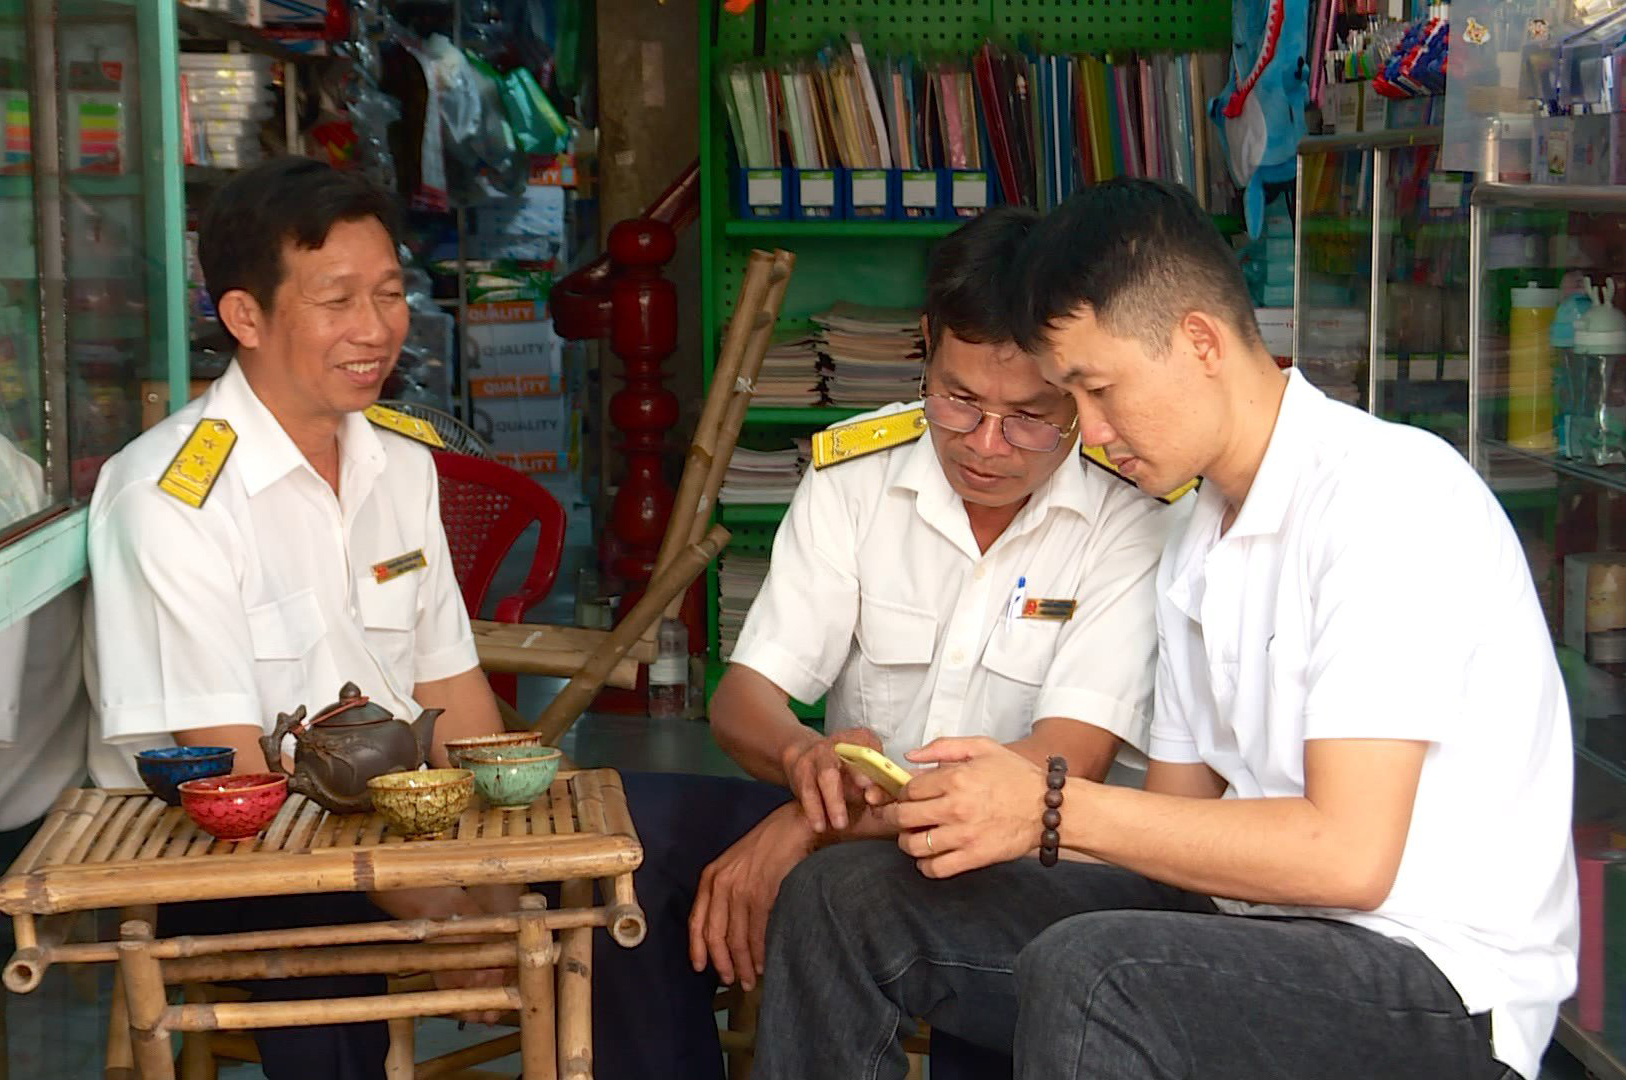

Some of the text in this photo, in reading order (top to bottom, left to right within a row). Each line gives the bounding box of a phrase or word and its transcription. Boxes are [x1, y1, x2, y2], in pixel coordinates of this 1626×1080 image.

[467, 307, 533, 321] QUALITY
[482, 343, 544, 356] QUALITY
[483, 382, 547, 395] QUALITY
[495, 419, 558, 433] QUALITY
